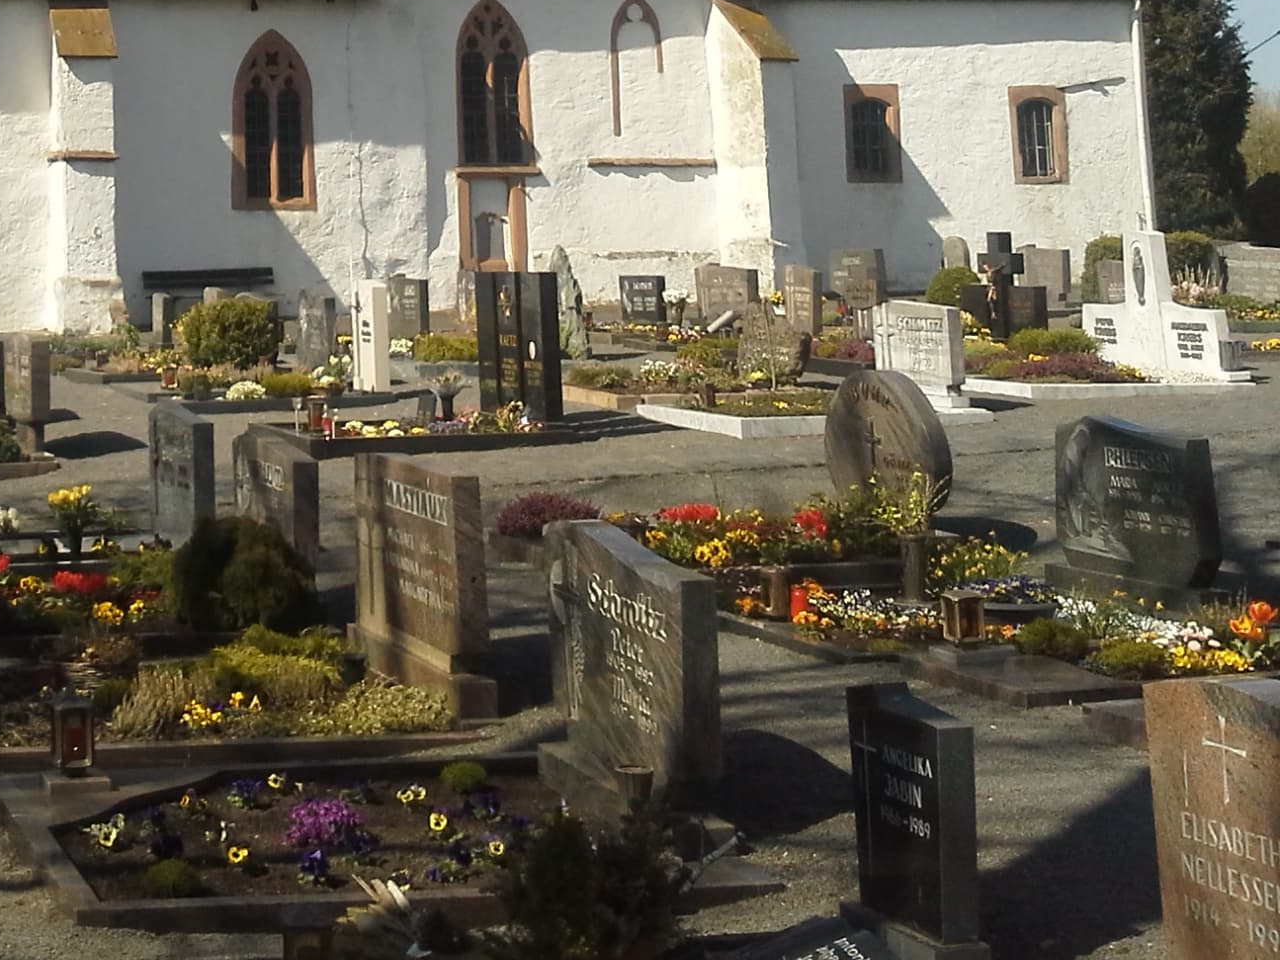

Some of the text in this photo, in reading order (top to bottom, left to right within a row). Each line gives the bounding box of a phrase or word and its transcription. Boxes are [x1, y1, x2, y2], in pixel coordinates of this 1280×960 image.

[588, 572, 668, 644] Schmitz
[610, 626, 644, 664] Peter
[881, 743, 933, 779] ANGELIKA
[1180, 811, 1280, 868] ELISABETH
